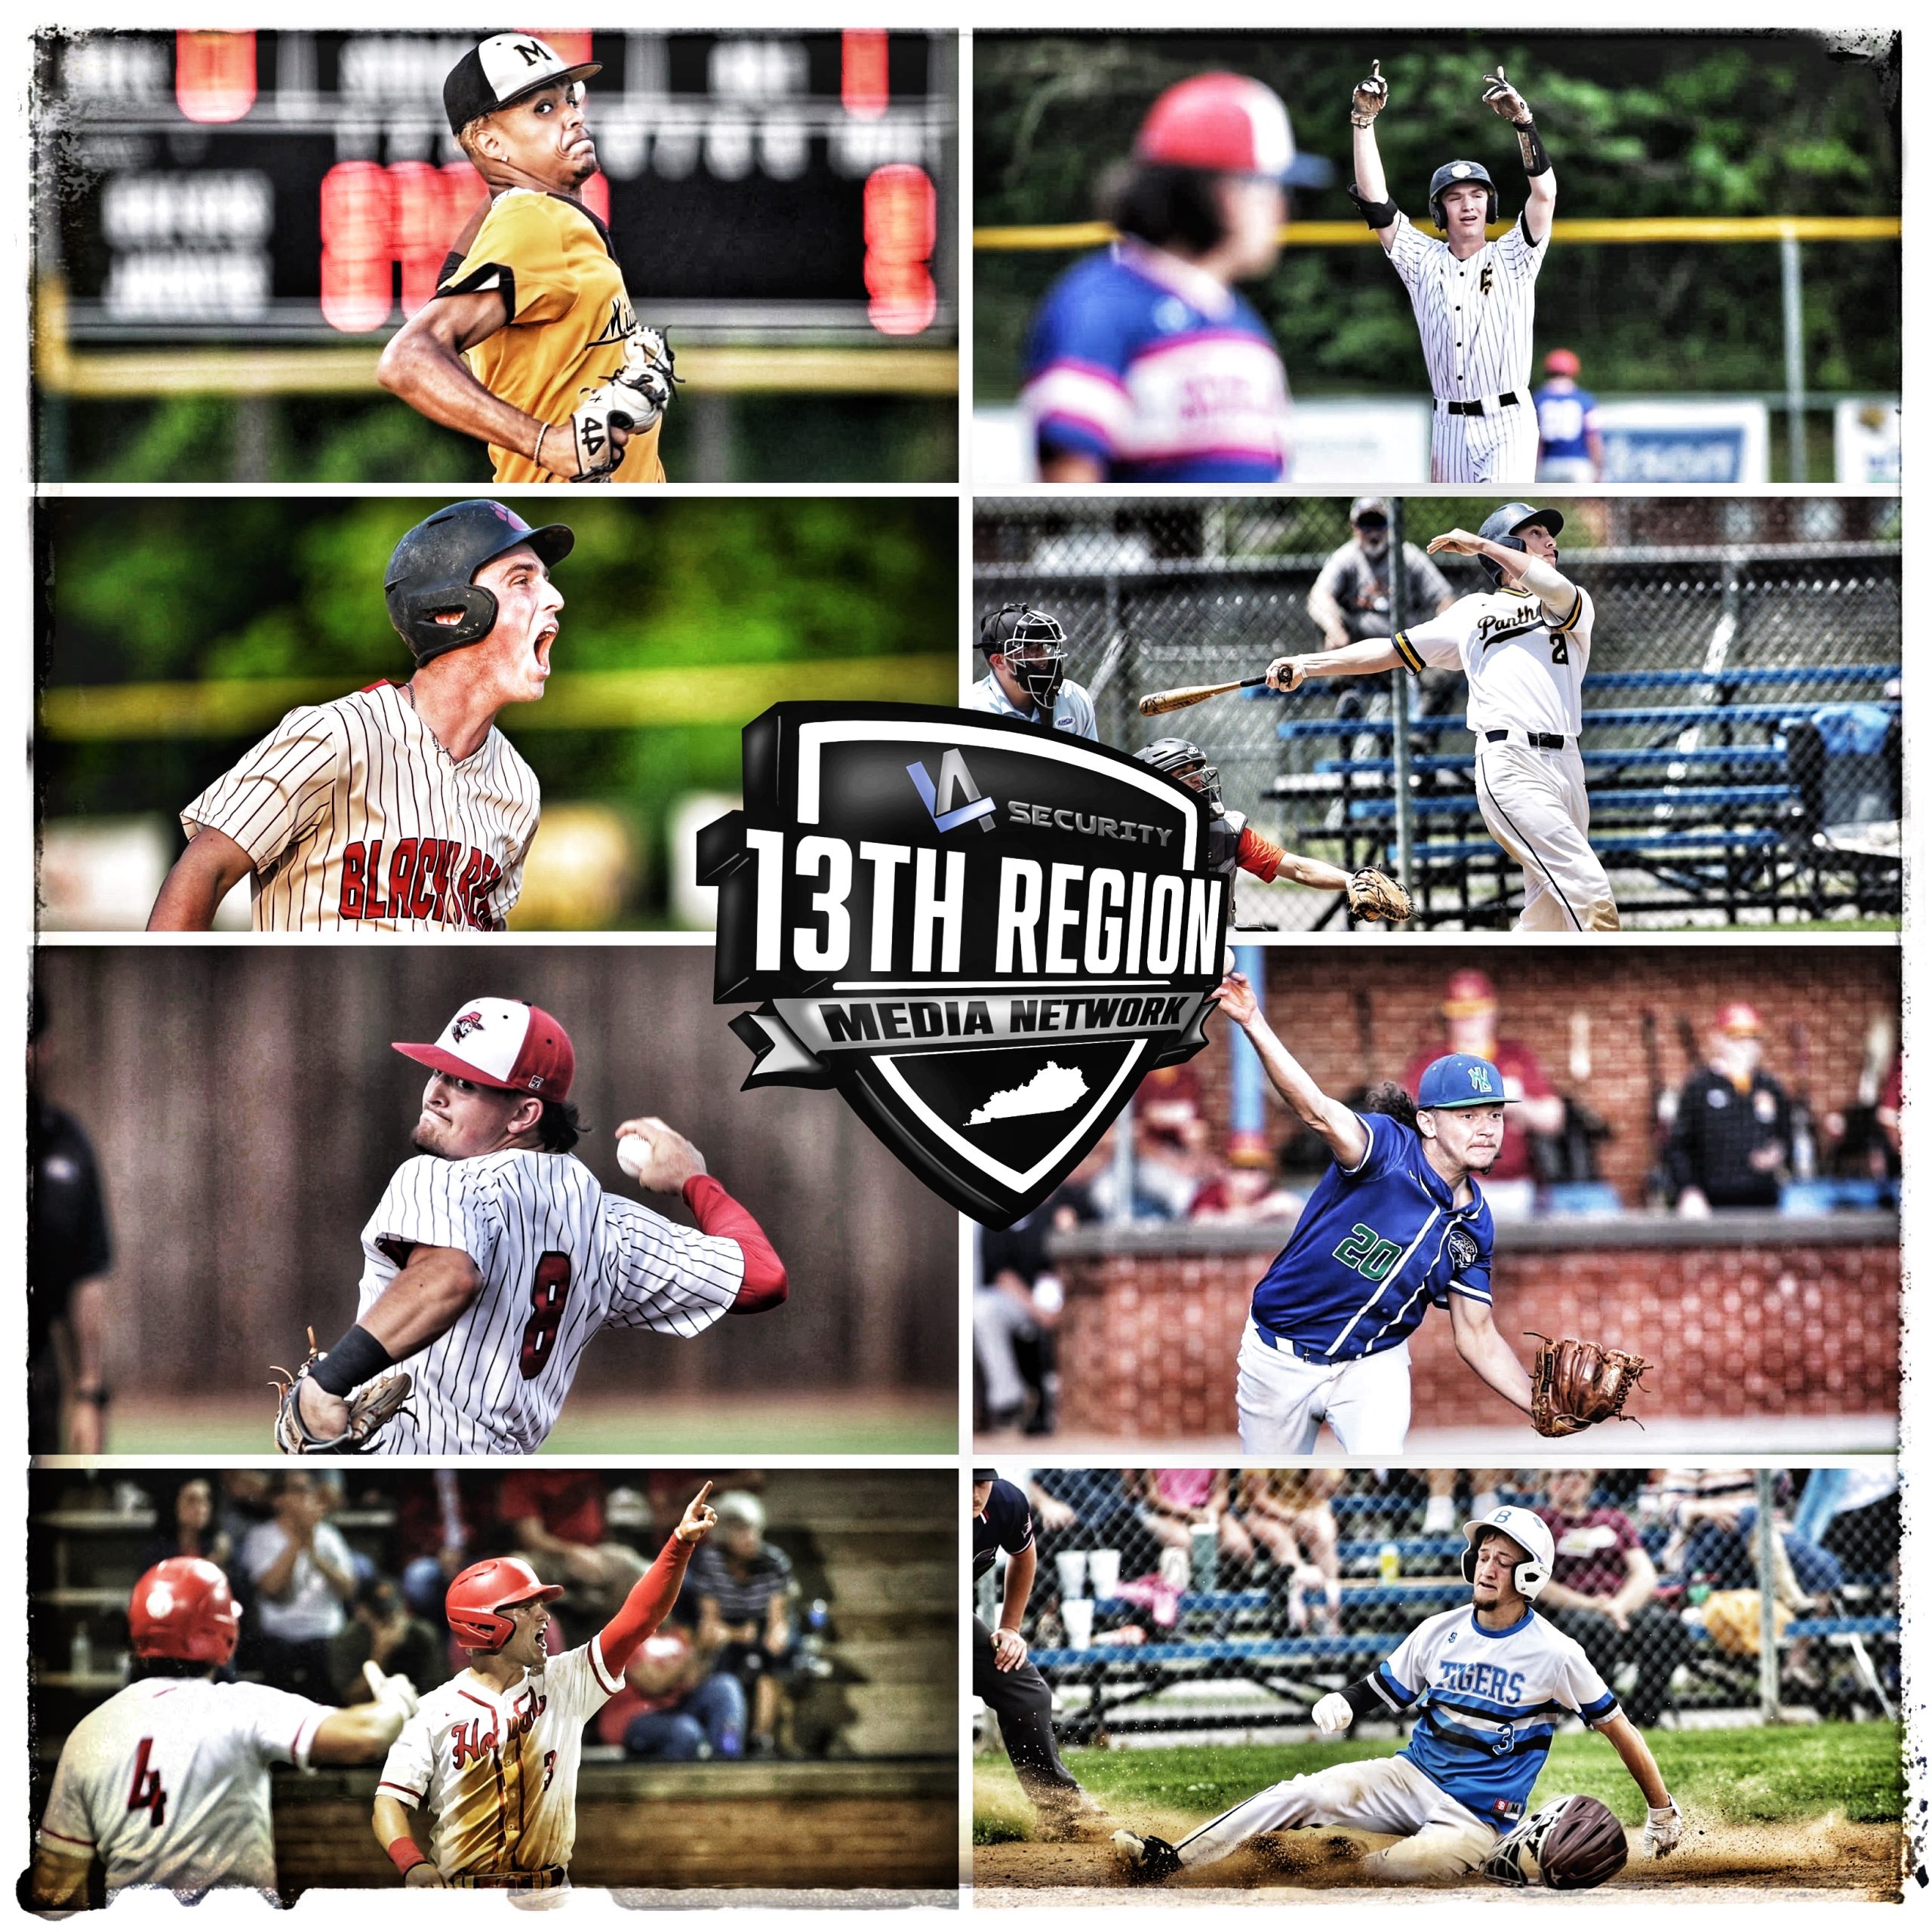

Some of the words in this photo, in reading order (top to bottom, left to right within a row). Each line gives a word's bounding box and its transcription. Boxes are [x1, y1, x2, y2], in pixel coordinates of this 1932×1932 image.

[513, 40, 552, 66] M
[338, 837, 462, 925] BLACK
[1332, 1223, 1402, 1281] 20
[518, 1251, 572, 1381] 8
[1494, 1510, 1512, 1523] B
[1439, 1661, 1526, 1704] TIGERS
[1493, 1721, 1514, 1755] 3
[128, 1737, 167, 1829] 4
